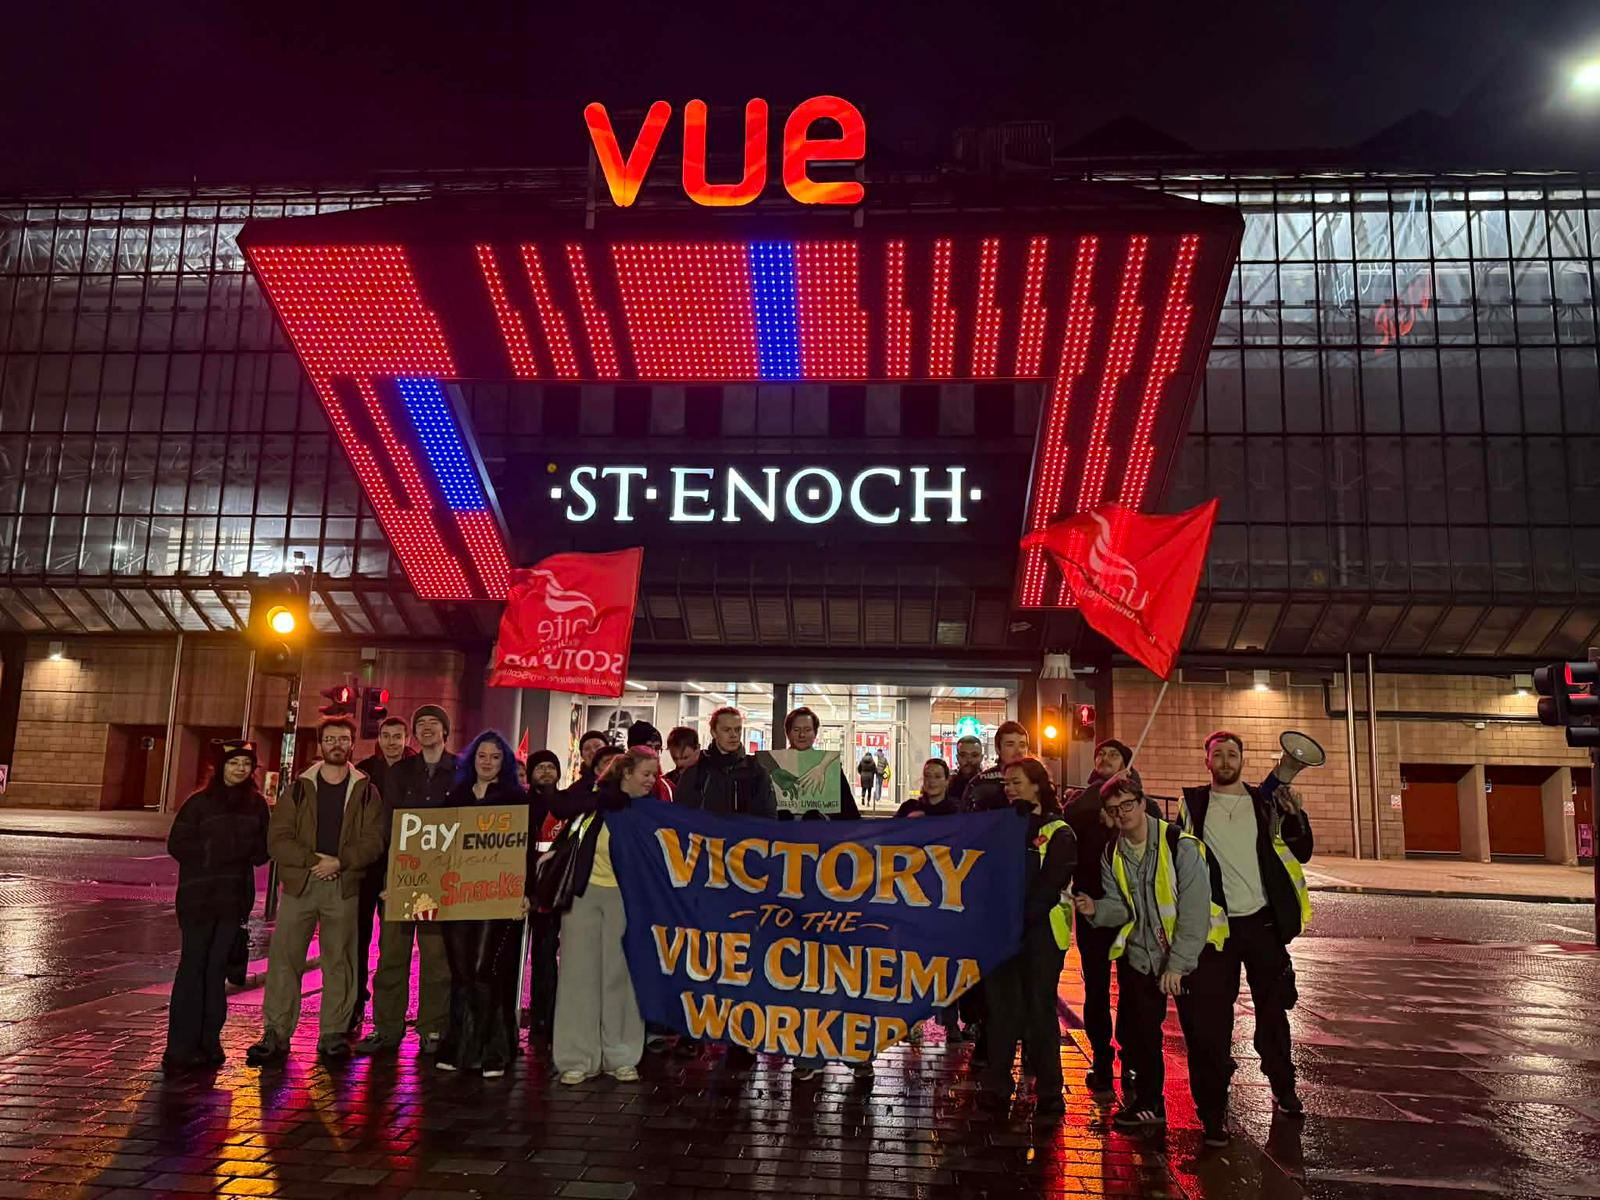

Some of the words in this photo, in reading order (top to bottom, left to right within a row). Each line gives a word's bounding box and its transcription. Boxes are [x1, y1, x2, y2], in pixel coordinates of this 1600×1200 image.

[584, 95, 866, 207] vue
[399, 812, 461, 852] Pay
[462, 832, 528, 850] ENOUGH
[396, 871, 430, 888] YOUR
[654, 828, 986, 912] VICTORY
[758, 904, 795, 928] TO
[802, 911, 863, 933] THE
[651, 924, 753, 986] VUE
[764, 937, 982, 1008] CINEMA
[680, 991, 925, 1062] WORKER
